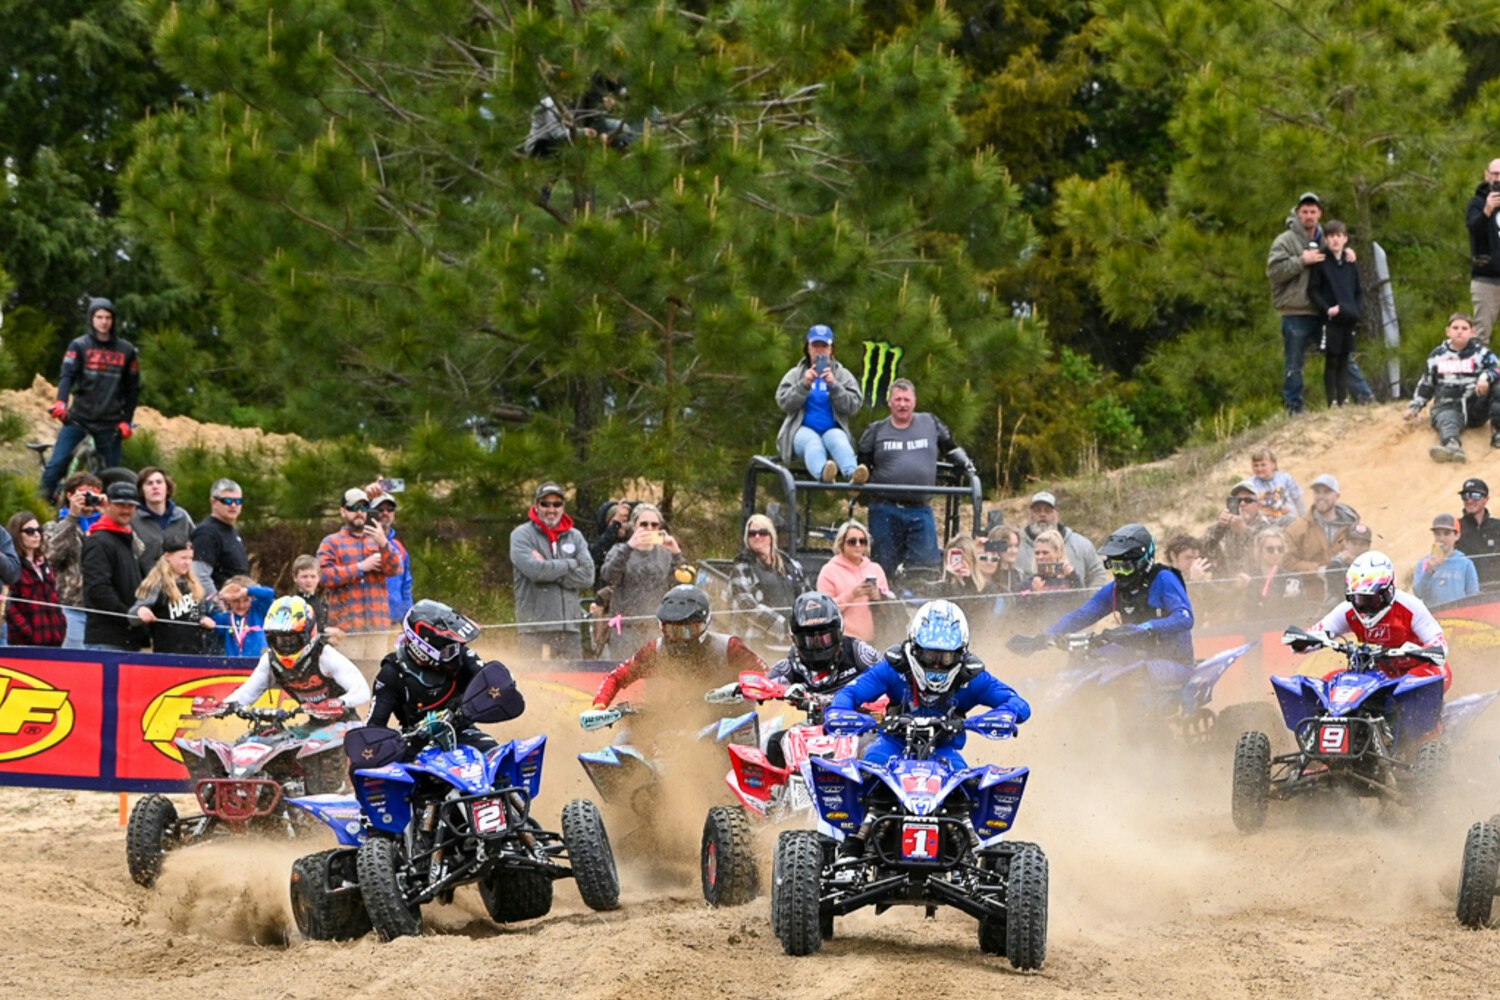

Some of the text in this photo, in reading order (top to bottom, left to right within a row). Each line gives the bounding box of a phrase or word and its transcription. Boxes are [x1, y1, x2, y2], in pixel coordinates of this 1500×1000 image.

[883, 441, 903, 451] TEAM
[457, 623, 476, 639] FLY
[0, 674, 69, 735] F
[1322, 728, 1345, 748] 9
[477, 804, 502, 831] 2
[910, 830, 929, 857] 1
